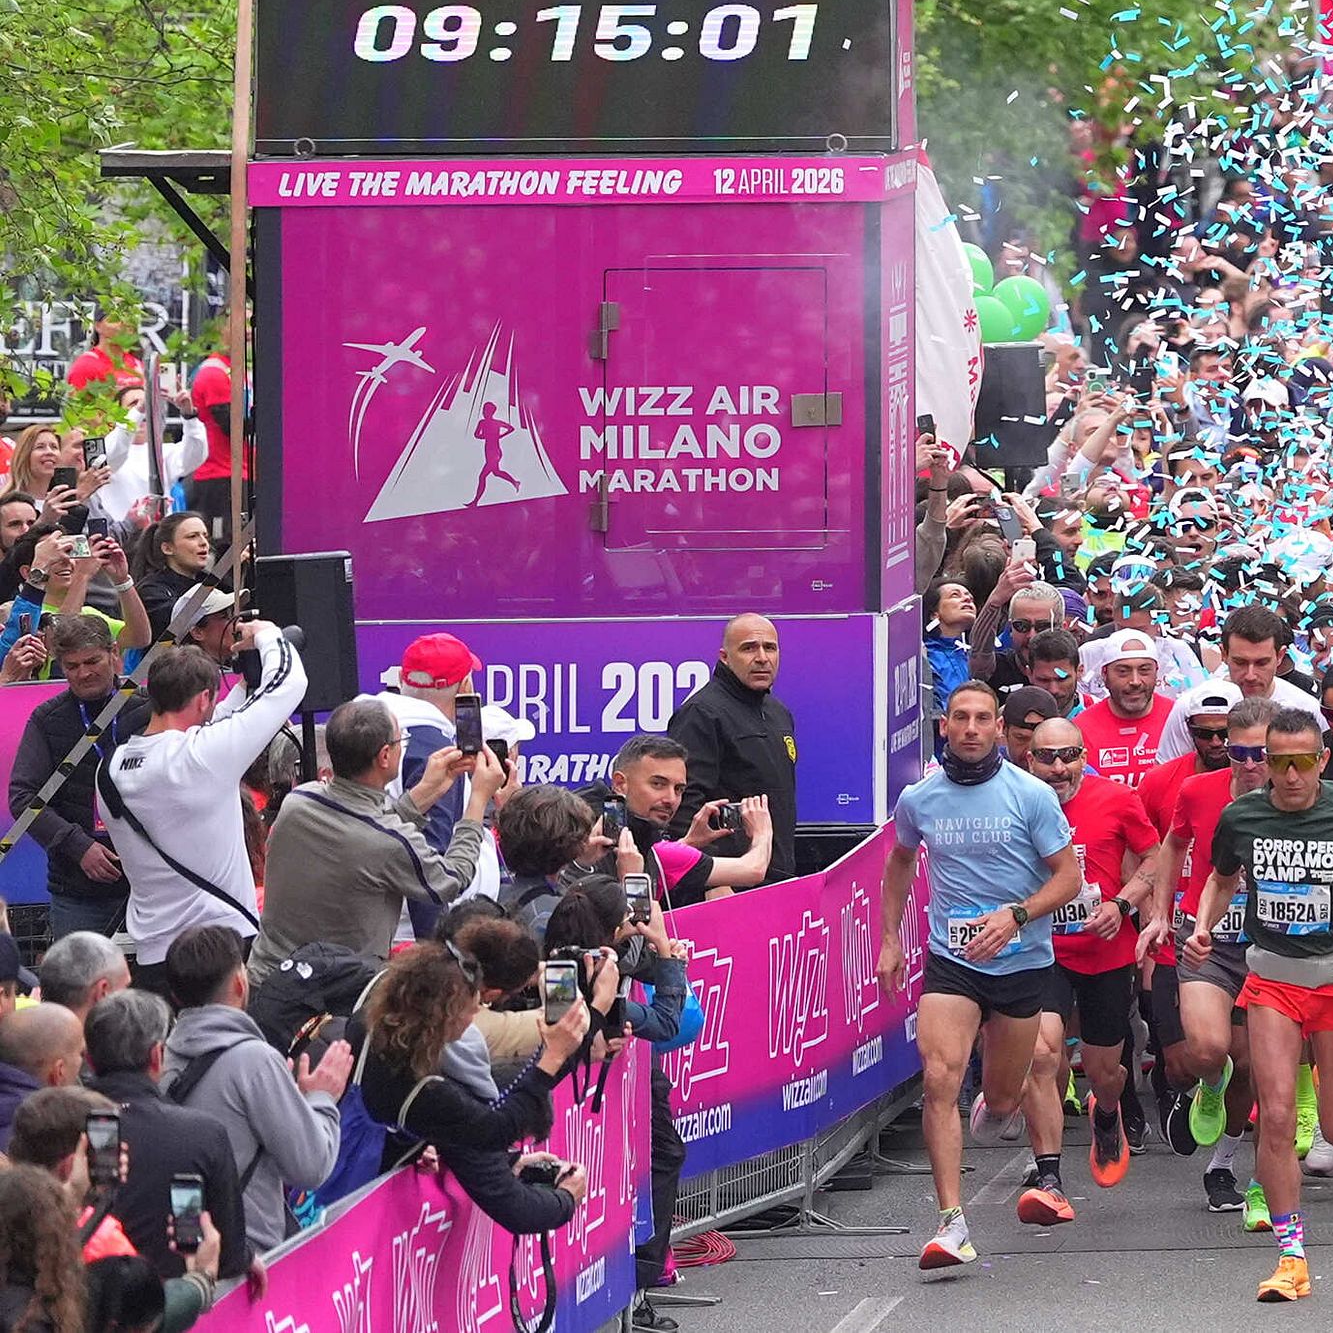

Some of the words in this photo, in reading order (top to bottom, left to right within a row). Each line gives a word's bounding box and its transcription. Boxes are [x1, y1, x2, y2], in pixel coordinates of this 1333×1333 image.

[352, 3, 820, 62] 09:15:01
[277, 172, 337, 198] LIVE
[340, 171, 400, 197] THE
[404, 170, 560, 197] MARATHON
[565, 167, 684, 196] FEELING
[714, 168, 736, 194] 12
[738, 168, 789, 195] APRIL
[790, 167, 845, 195] 2026
[578, 387, 693, 416] WIZZ
[708, 386, 780, 414] AIR
[579, 423, 782, 460] MILANO
[579, 468, 780, 494] MARATHON
[602, 660, 716, 733] 202
[119, 757, 147, 771] NIKE
[517, 753, 616, 784] ARATH
[934, 815, 1012, 831] NAVIGLIO
[934, 831, 965, 845] RUN
[972, 830, 1012, 844] CLUB
[1253, 838, 1305, 852] CORRO
[1253, 864, 1307, 882] CAMP
[1269, 900, 1317, 923] 1852A
[782, 1068, 829, 1112] wizzair.com
